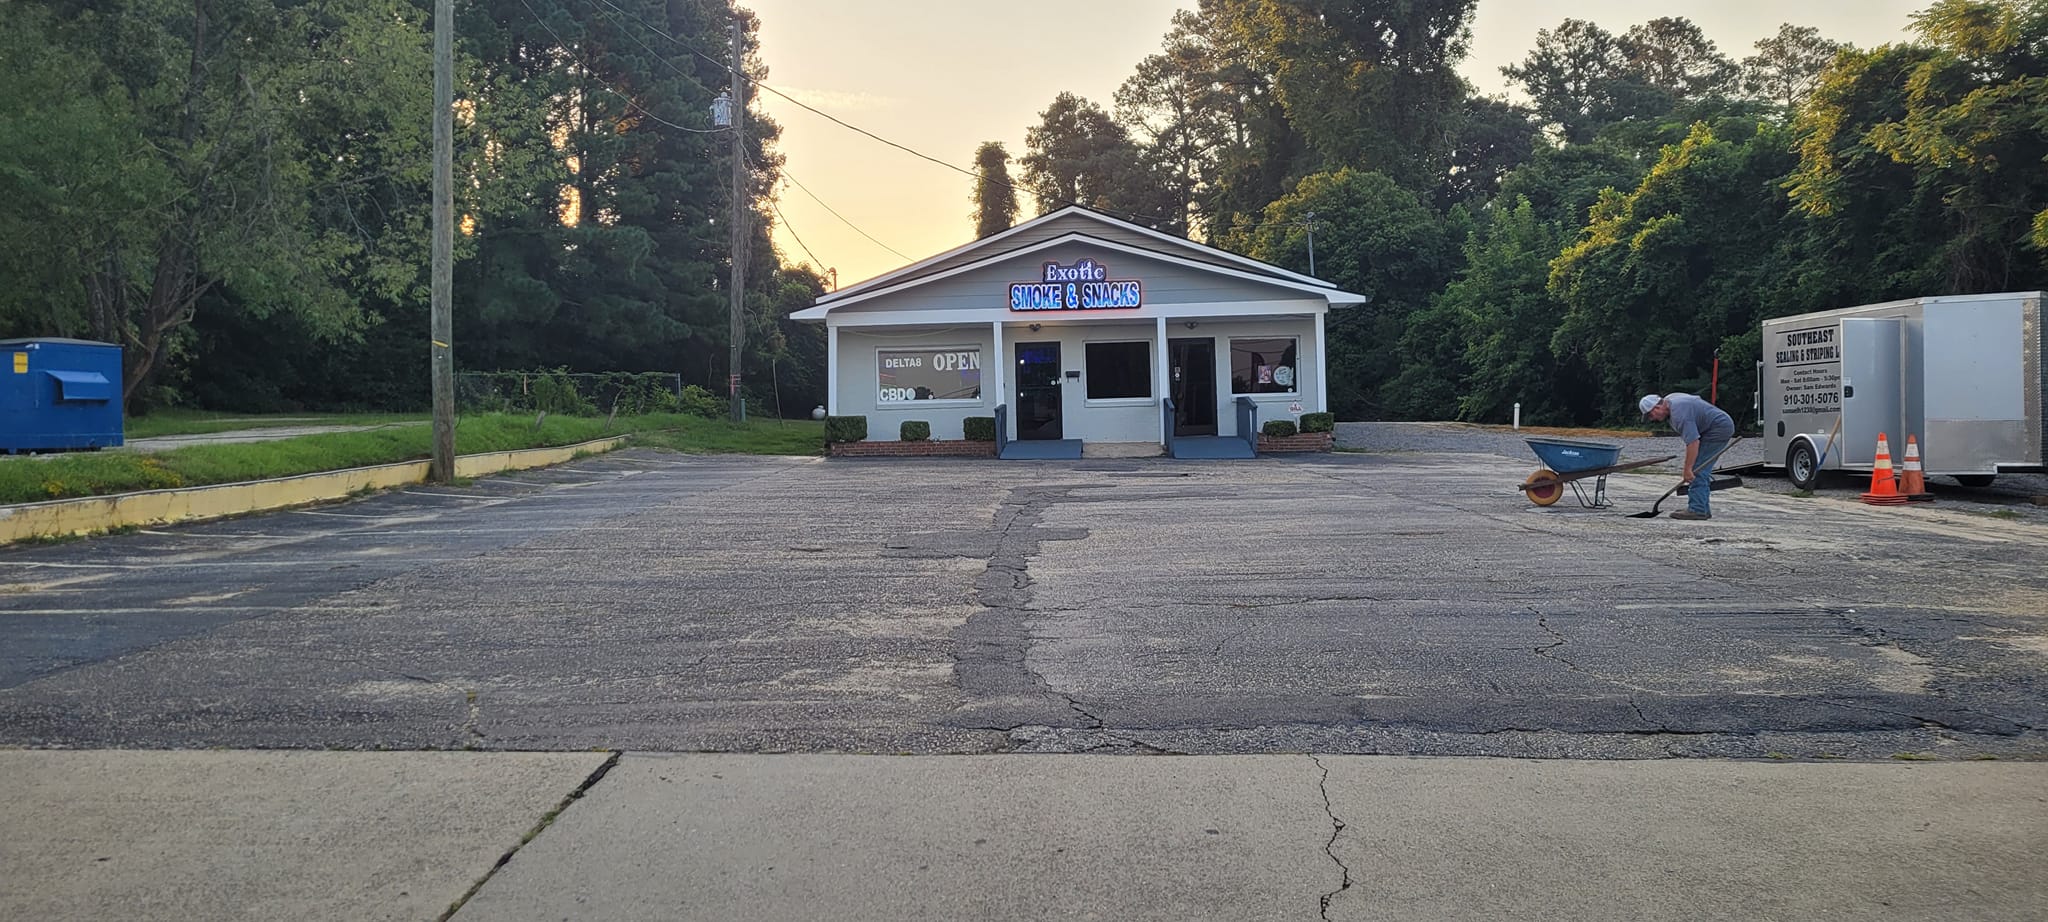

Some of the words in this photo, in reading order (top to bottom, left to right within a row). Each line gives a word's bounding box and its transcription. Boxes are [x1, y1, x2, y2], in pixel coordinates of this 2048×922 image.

[1046, 260, 1104, 281] Exotic
[1011, 284, 1062, 310] SMOKE
[1066, 283, 1079, 309] &
[1082, 281, 1140, 308] SNACKS
[1787, 329, 1834, 347] SOUTHEAST
[885, 357, 922, 368] DELTA8
[933, 351, 980, 371] OPEN
[1776, 349, 1799, 364] SEALING
[1806, 346, 1834, 361] STRIPING
[1783, 392, 1839, 406] 910-301-5076
